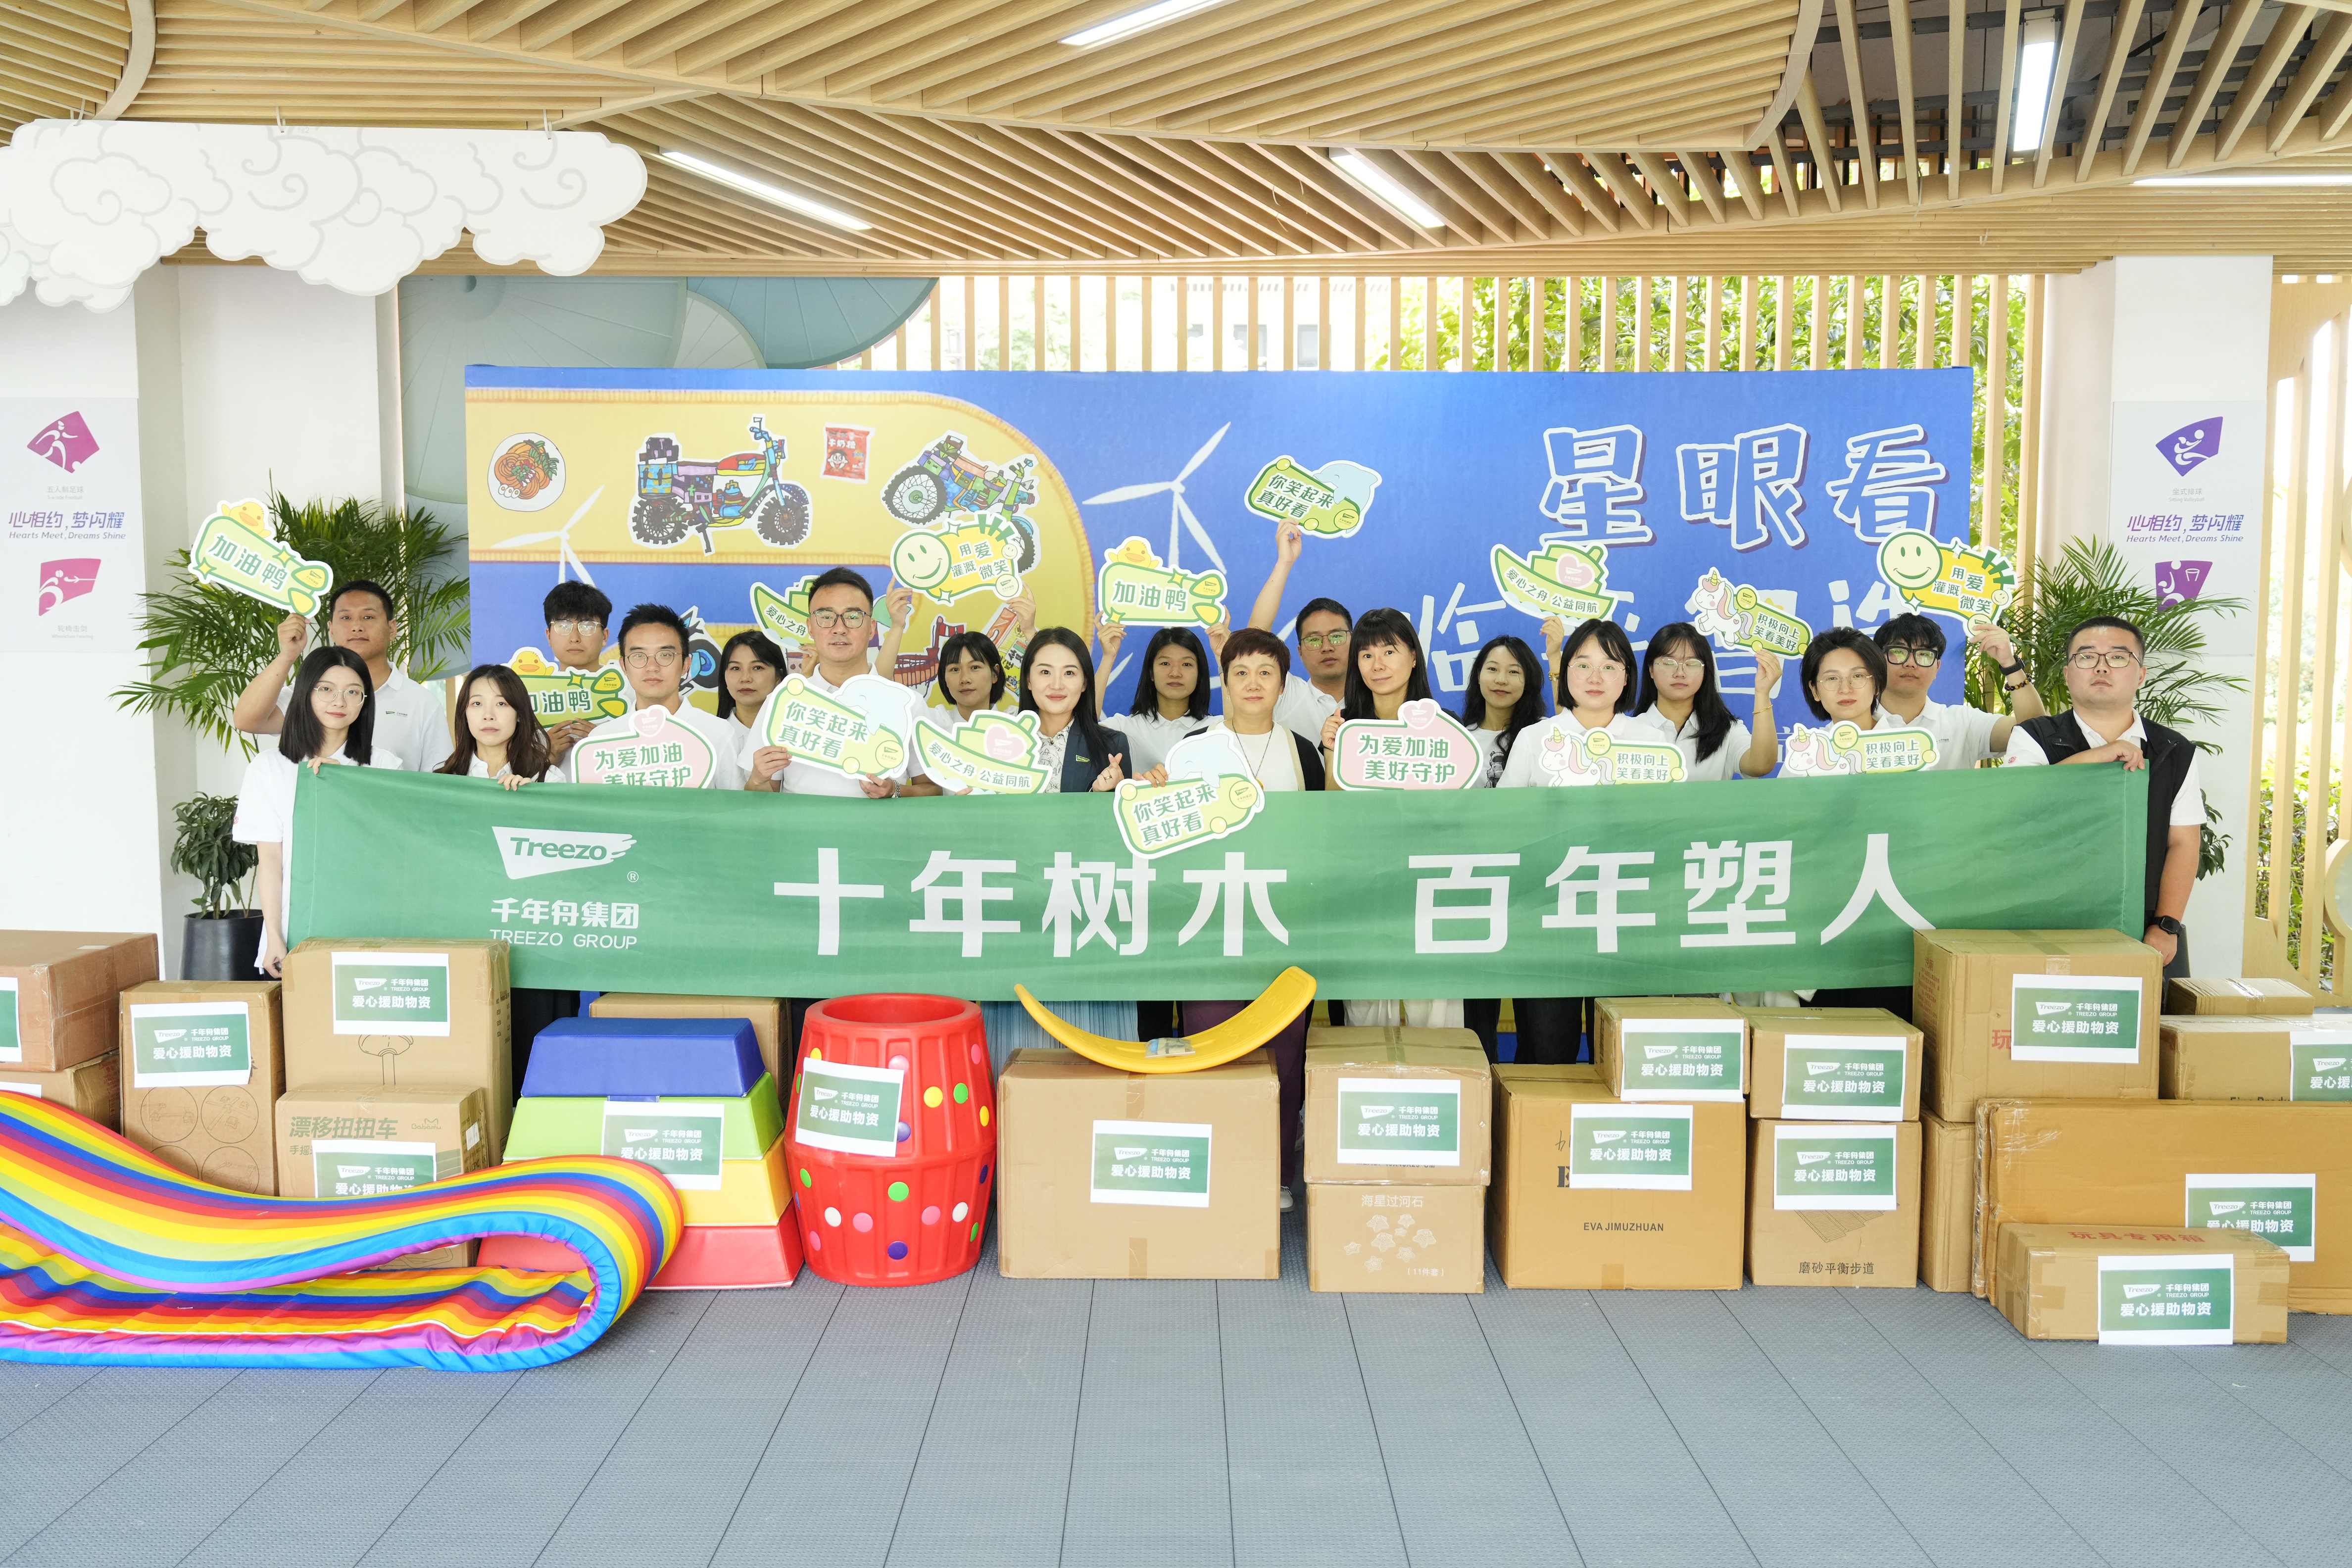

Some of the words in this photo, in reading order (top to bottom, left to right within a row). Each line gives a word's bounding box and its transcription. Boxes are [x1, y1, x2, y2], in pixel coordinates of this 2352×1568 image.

[1268, 475, 1334, 509] 你笑起来
[1257, 490, 1309, 518] 真好看
[959, 541, 991, 559] 用爱
[208, 535, 288, 590] 加油鸭
[952, 560, 976, 577] 灌溉
[979, 559, 1009, 580] 微笑
[1952, 567, 1983, 591] 用爱
[1113, 581, 1186, 611] 加油鸭
[1506, 569, 1548, 601] 爱心之舟
[1552, 595, 1598, 613] 公益同航
[1933, 581, 1960, 596] 灌溉
[1960, 595, 1992, 614] 微笑
[766, 606, 806, 636] 爱心之舟
[1758, 613, 1799, 640] 积极向上
[1753, 626, 1797, 651] 笑看美好
[786, 701, 868, 742] 你笑起来
[778, 724, 842, 758] 真好看
[1359, 735, 1449, 758] 为爱加油
[1865, 739, 1919, 755] 积极向上
[595, 742, 682, 771] 为爱加油
[929, 742, 975, 777] 爱心之舟
[980, 770, 1030, 787] 公益同航
[1617, 753, 1668, 766] 积极向上
[1866, 754, 1919, 769] 笑看美好
[1365, 760, 1455, 783] 美好守护
[1617, 767, 1668, 781] 笑看美好
[1133, 784, 1216, 823] 你笑起来
[1140, 811, 1202, 846] 真好看
[510, 837, 607, 860] Treezo
[774, 847, 1289, 958] 十年树木
[1408, 833, 1936, 954] 百年塑人
[491, 897, 639, 929] 千年舟集团
[490, 929, 563, 946] TREEZO
[574, 934, 637, 949] GROUP
[352, 995, 431, 1009] 爱心援助物资
[191, 1028, 229, 1036] 千年舟集团
[2032, 1020, 2119, 1034] 爱心援助物资
[153, 1045, 232, 1060] 爱心援助物资
[1641, 1063, 1723, 1077] 爱心援助物资
[1845, 1063, 1884, 1071] 千年舟集团
[1804, 1080, 1885, 1094] 爱心援助物资
[841, 1092, 879, 1103] 千年舟集团
[809, 1104, 879, 1127] 爱心援助物资
[289, 1116, 398, 1139] 漂移扭扭车
[1358, 1124, 1440, 1137] 爱心援助物资
[290, 1145, 313, 1156] 手摇
[621, 1147, 702, 1161] 爱心援助物资
[1151, 1149, 1189, 1157] 千年舟集团
[1590, 1148, 1672, 1162] 爱心援助物资
[1835, 1151, 1874, 1160] 千年舟集团
[1111, 1164, 1191, 1180] 爱心援助物资
[1794, 1169, 1876, 1182] 爱心援助物资
[336, 1183, 414, 1196] 爱心援助物
[1362, 1194, 1423, 1207] 海星过河石
[2250, 1201, 2292, 1210] 千年舟集团
[1584, 1222, 1603, 1230] EVA
[1605, 1223, 1664, 1231] JIMUZHUAN
[2068, 1230, 2205, 1243] 玩具专用箱
[1799, 1261, 1874, 1275] 磨砂平衡步道
[2165, 1283, 2209, 1292] 千年舟集团
[2120, 1302, 2211, 1317] 爱心援助物资
